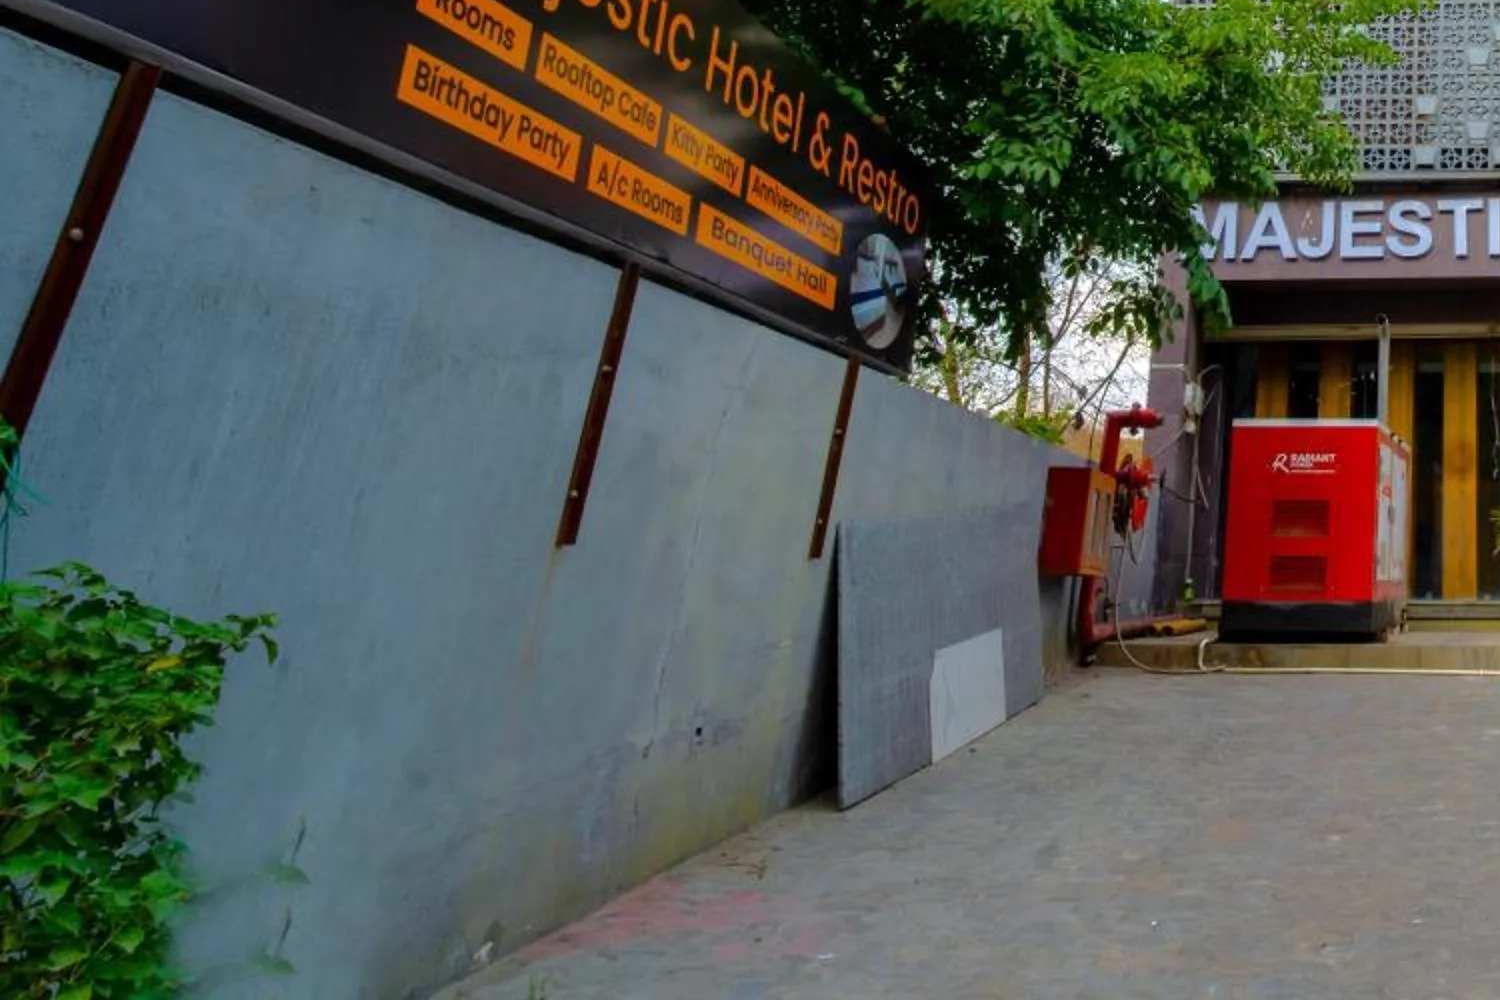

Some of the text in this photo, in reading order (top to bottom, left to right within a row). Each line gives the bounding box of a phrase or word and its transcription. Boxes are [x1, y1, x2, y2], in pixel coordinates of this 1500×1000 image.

[413, 59, 570, 170] Birthday Party
[543, 45, 656, 131] Rooftop Cafe
[672, 123, 738, 188] Kitty Party
[706, 26, 805, 153] Hotel
[809, 112, 832, 177] &
[839, 132, 919, 234] Restro
[596, 160, 683, 225] A/c Rooms
[711, 216, 827, 294] Banquet Hall
